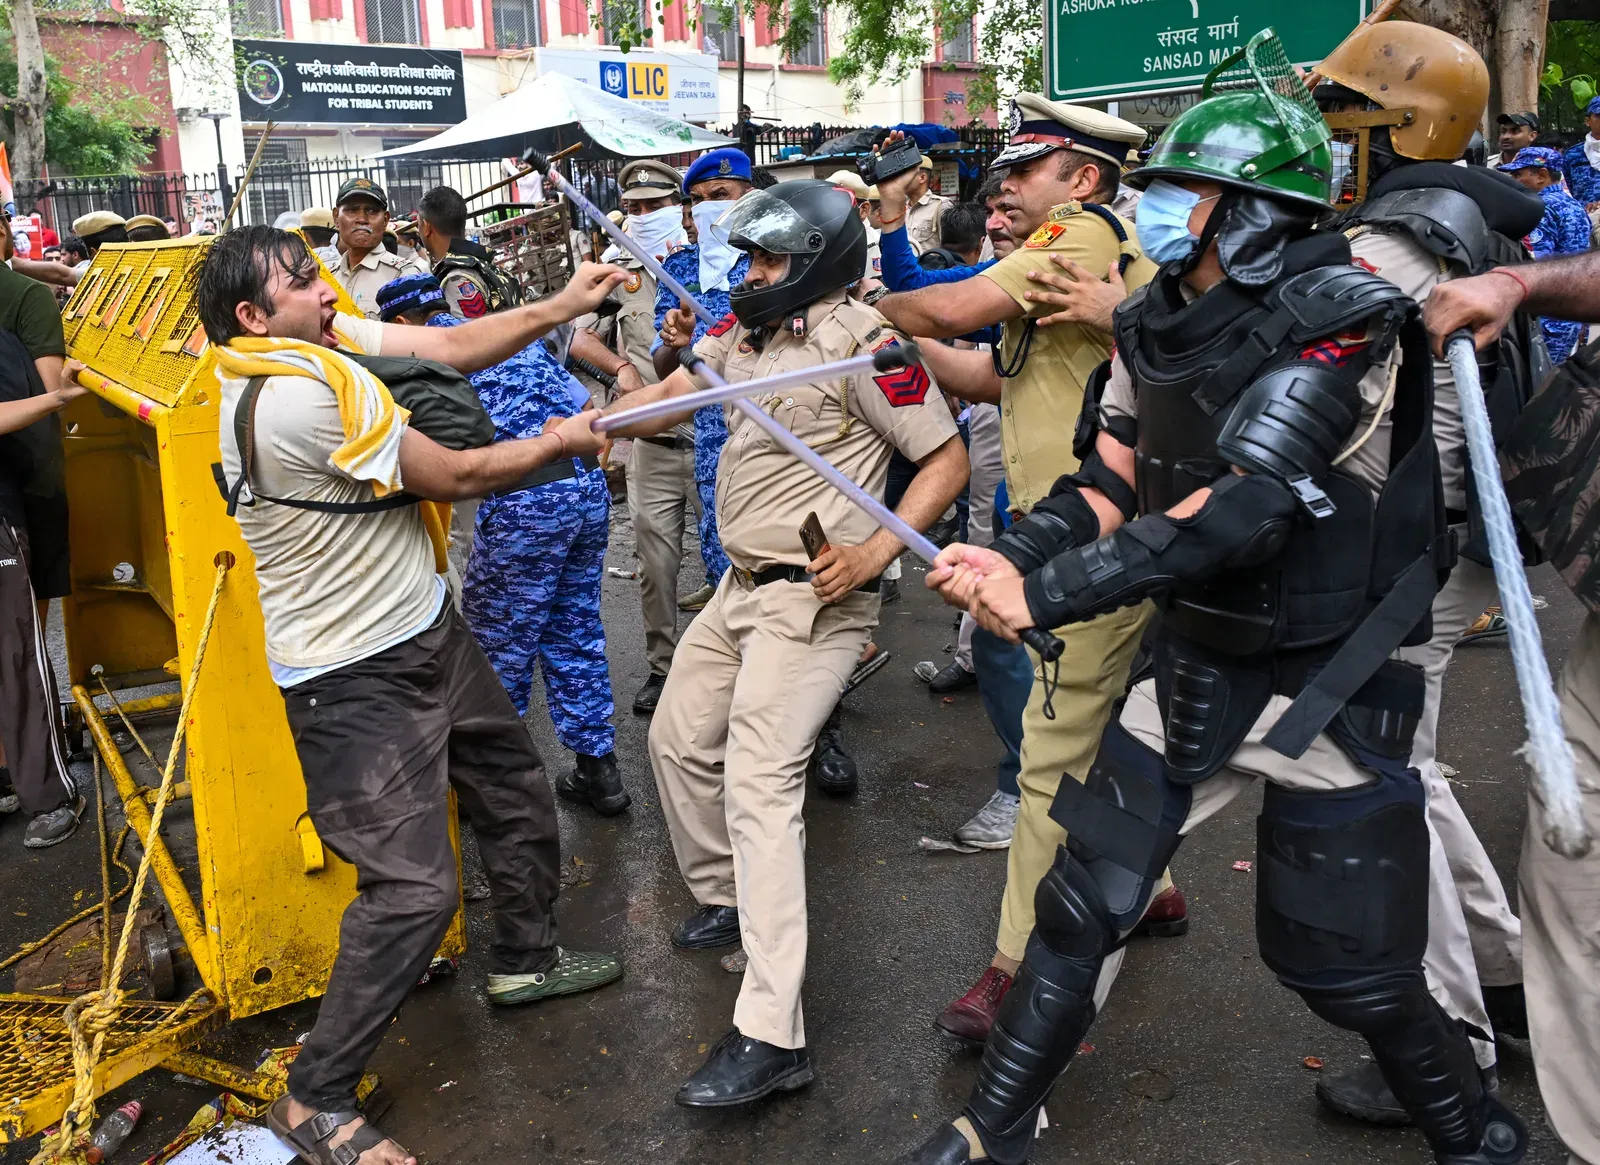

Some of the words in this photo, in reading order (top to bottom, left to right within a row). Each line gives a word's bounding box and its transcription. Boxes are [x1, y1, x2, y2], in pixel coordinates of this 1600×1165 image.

[1157, 26, 1198, 47] संसद
[1207, 16, 1240, 40] मार्ग
[295, 59, 331, 78] राष्ट्रीय
[332, 60, 379, 77] आदिवासी
[425, 64, 455, 80] समिति
[1143, 51, 1203, 73] SANSAD
[302, 81, 354, 93] NATIONAL
[355, 83, 412, 95] EDUCATION
[413, 85, 452, 96] SOCIETY
[632, 67, 664, 96] LIC
[328, 97, 349, 108] FOR
[349, 98, 383, 109] TRIBAL
[384, 99, 433, 110] STUDENTS
[674, 91, 698, 99] JEEVAN
[699, 91, 716, 99] TARA
